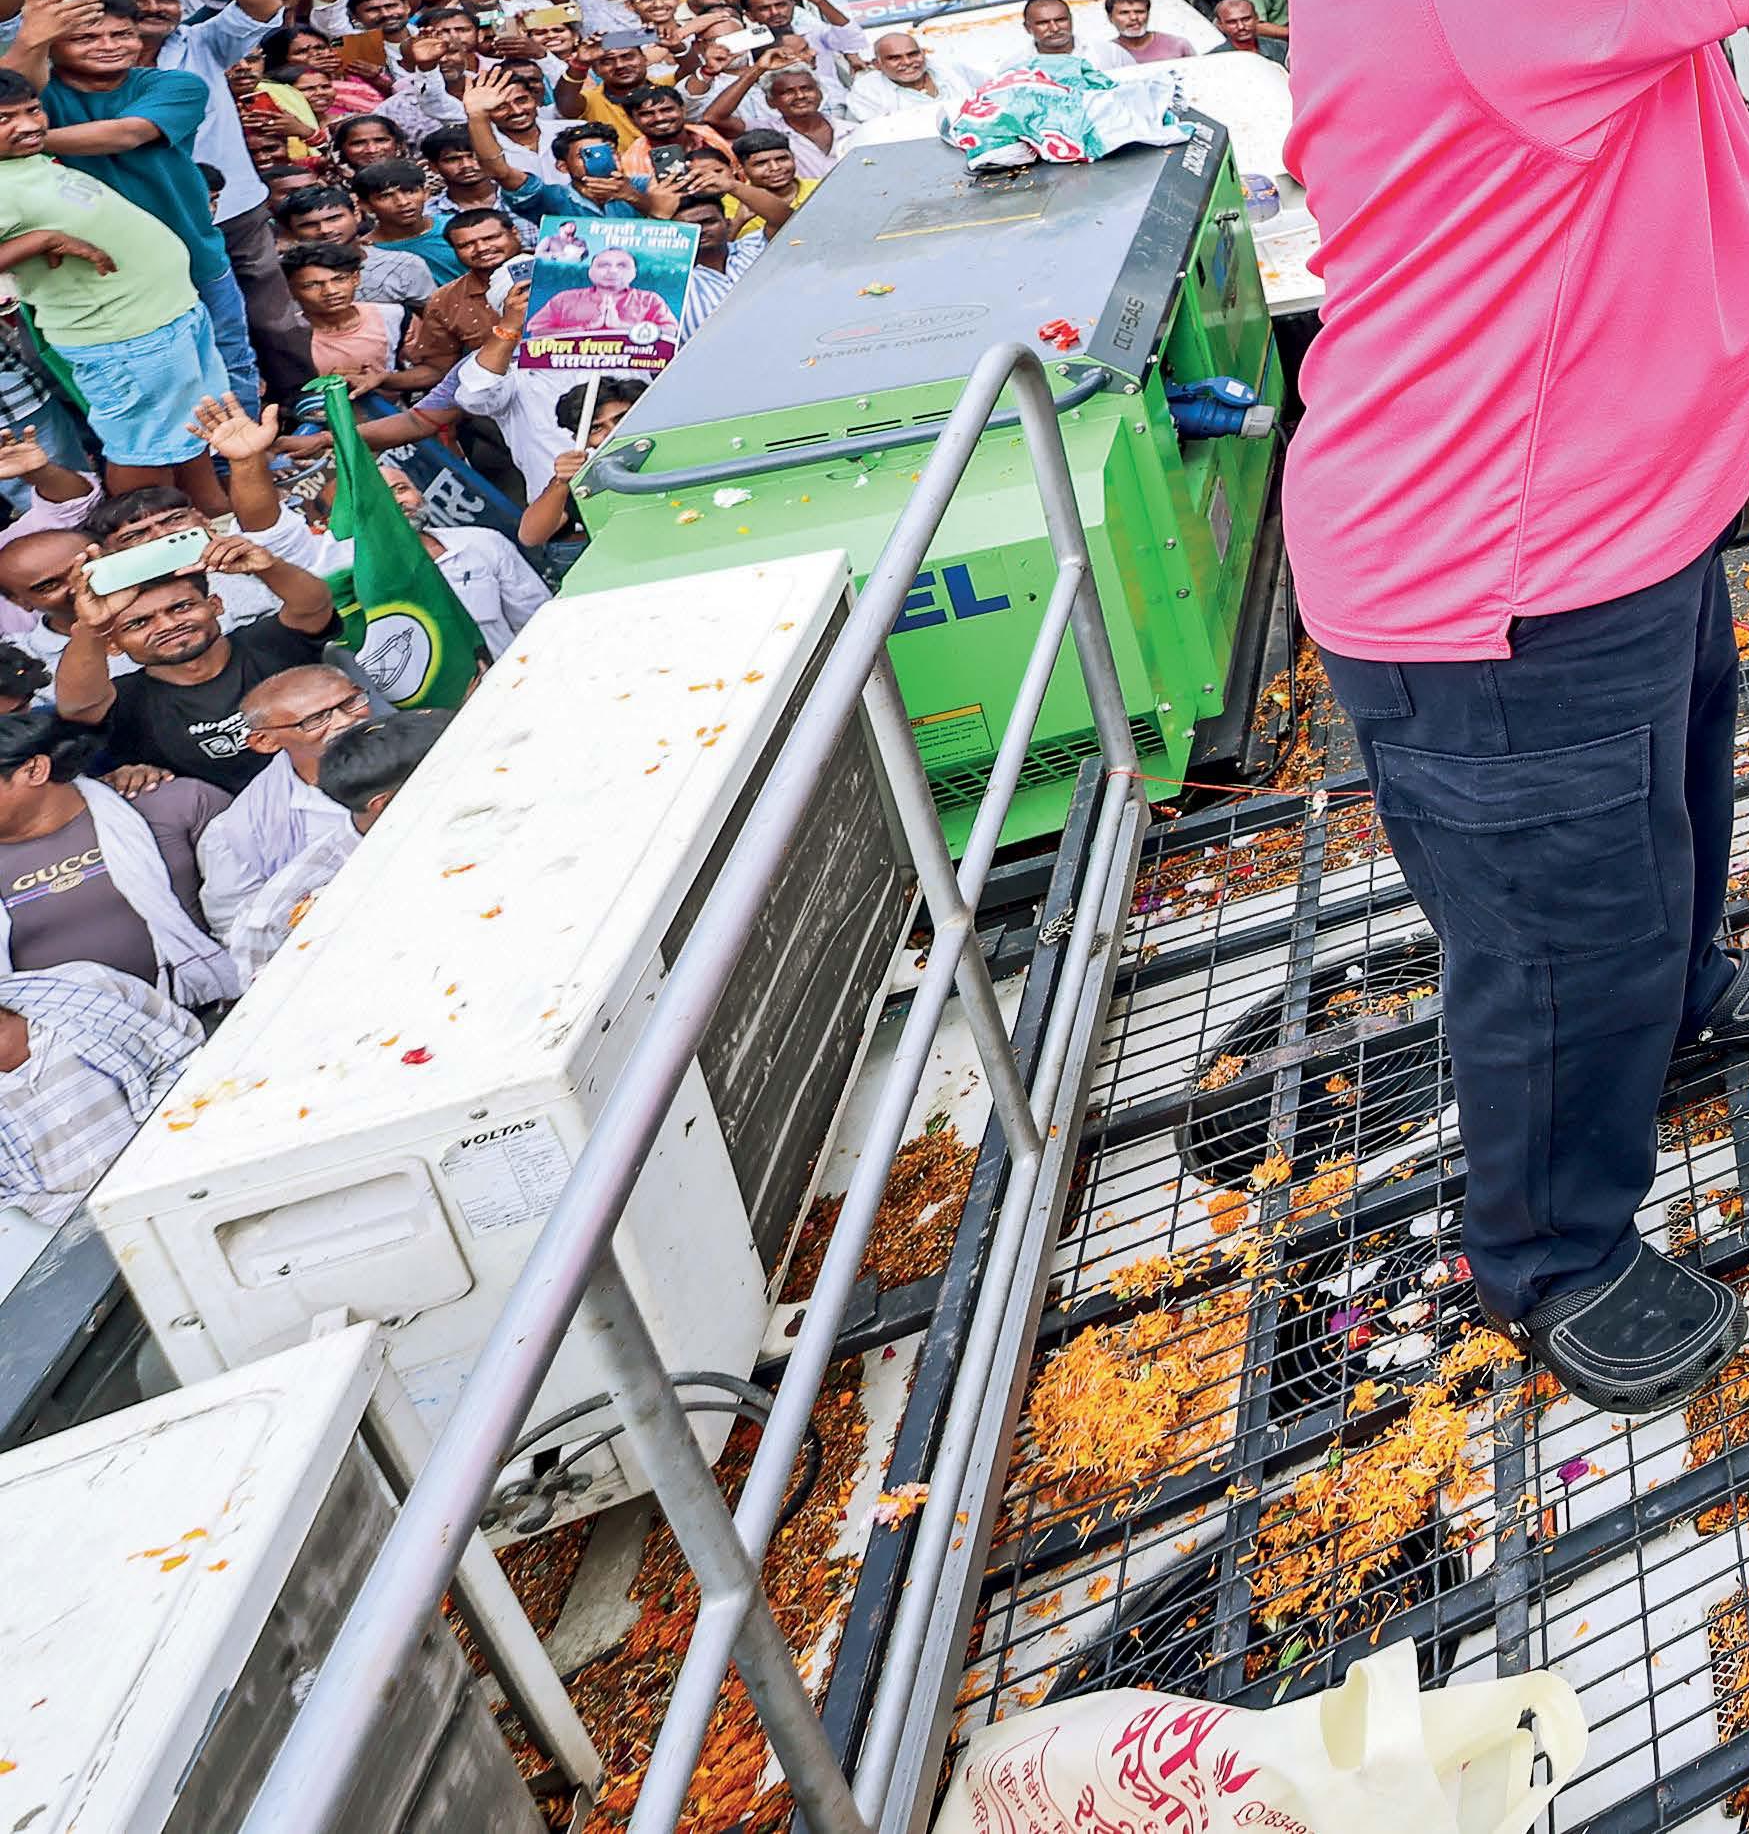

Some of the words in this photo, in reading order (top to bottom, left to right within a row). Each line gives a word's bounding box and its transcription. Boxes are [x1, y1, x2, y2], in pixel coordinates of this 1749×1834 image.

[890, 563, 1012, 635] EL
[12, 847, 102, 891] GUCC
[461, 1118, 537, 1149] VOLTAS
